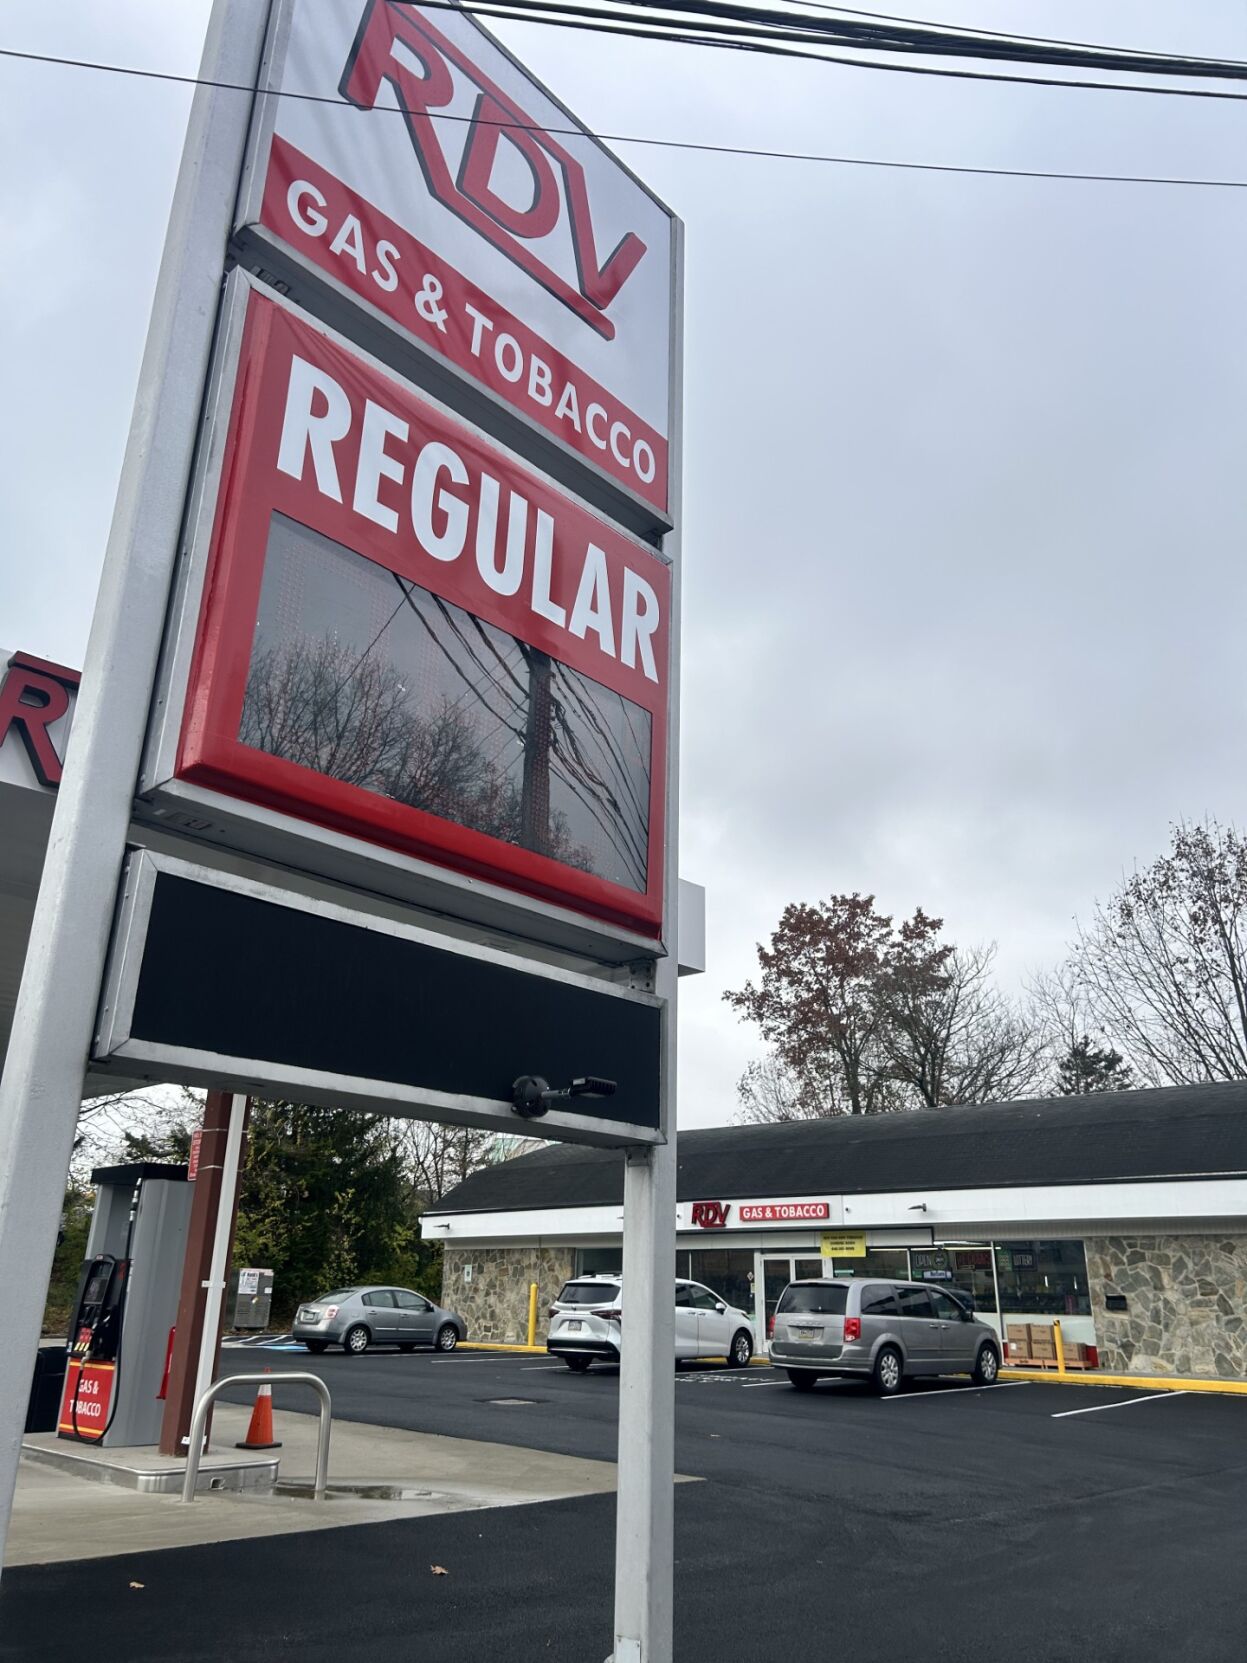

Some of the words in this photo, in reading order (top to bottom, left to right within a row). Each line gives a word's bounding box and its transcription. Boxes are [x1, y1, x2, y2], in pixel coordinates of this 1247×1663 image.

[338, 0, 648, 341] RDV
[286, 178, 401, 292] GAS
[414, 273, 449, 334] &
[464, 302, 657, 484] TOBACCO
[276, 353, 660, 684] REGULAR
[691, 1201, 731, 1228] RDV
[743, 1208, 763, 1218] GAS
[766, 1207, 773, 1218] &
[775, 1205, 825, 1218] TOBACCO
[79, 1379, 93, 1394] GAS
[92, 1380, 99, 1395] &
